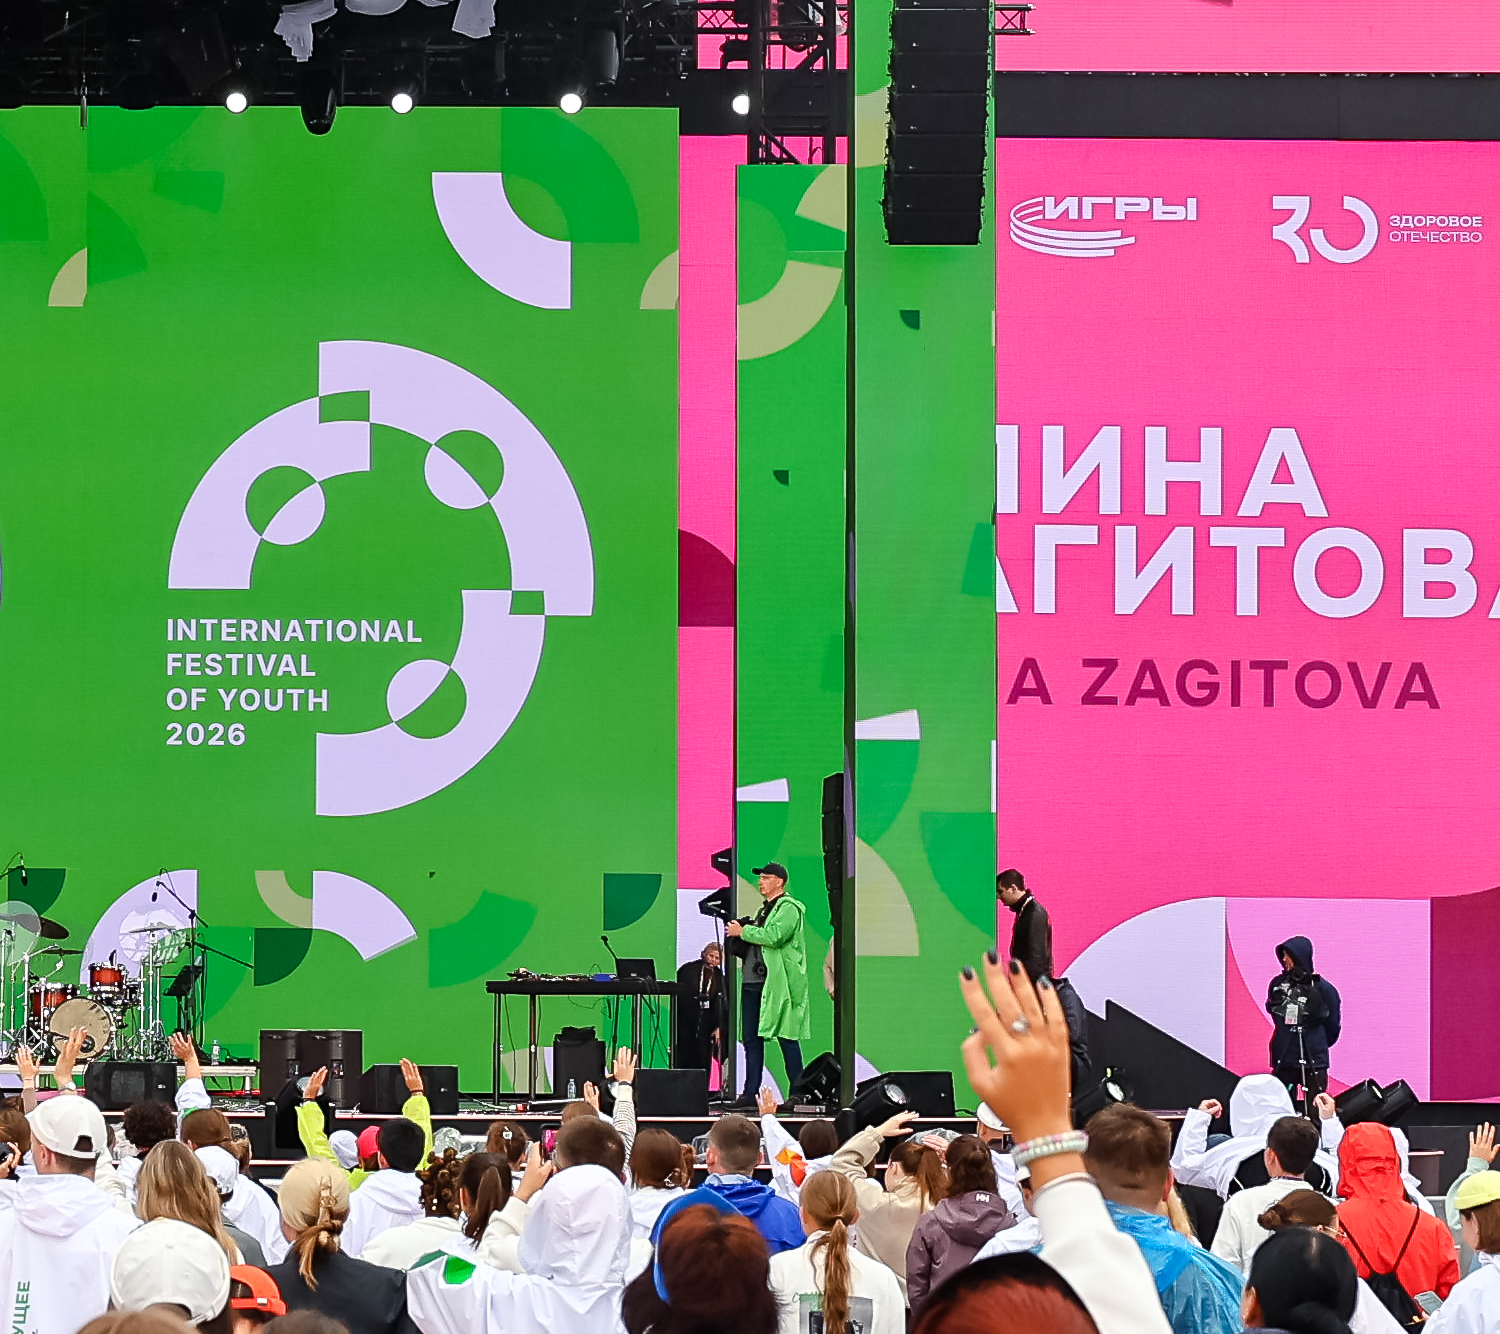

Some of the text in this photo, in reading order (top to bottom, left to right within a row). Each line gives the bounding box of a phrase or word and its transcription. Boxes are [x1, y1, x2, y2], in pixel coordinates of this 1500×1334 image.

[1043, 196, 1197, 221] ИГРЫ
[1389, 215, 1483, 228] ЗДОРОВОЕ
[1389, 231, 1483, 243] ОТЕЧЕСТВО
[168, 619, 421, 642] INTERNATIONAL
[168, 654, 315, 676] FESTIVAL
[1081, 657, 1440, 711] ZAGITOVA
[167, 688, 327, 711] OF YOUTH
[167, 723, 245, 745] 2026
